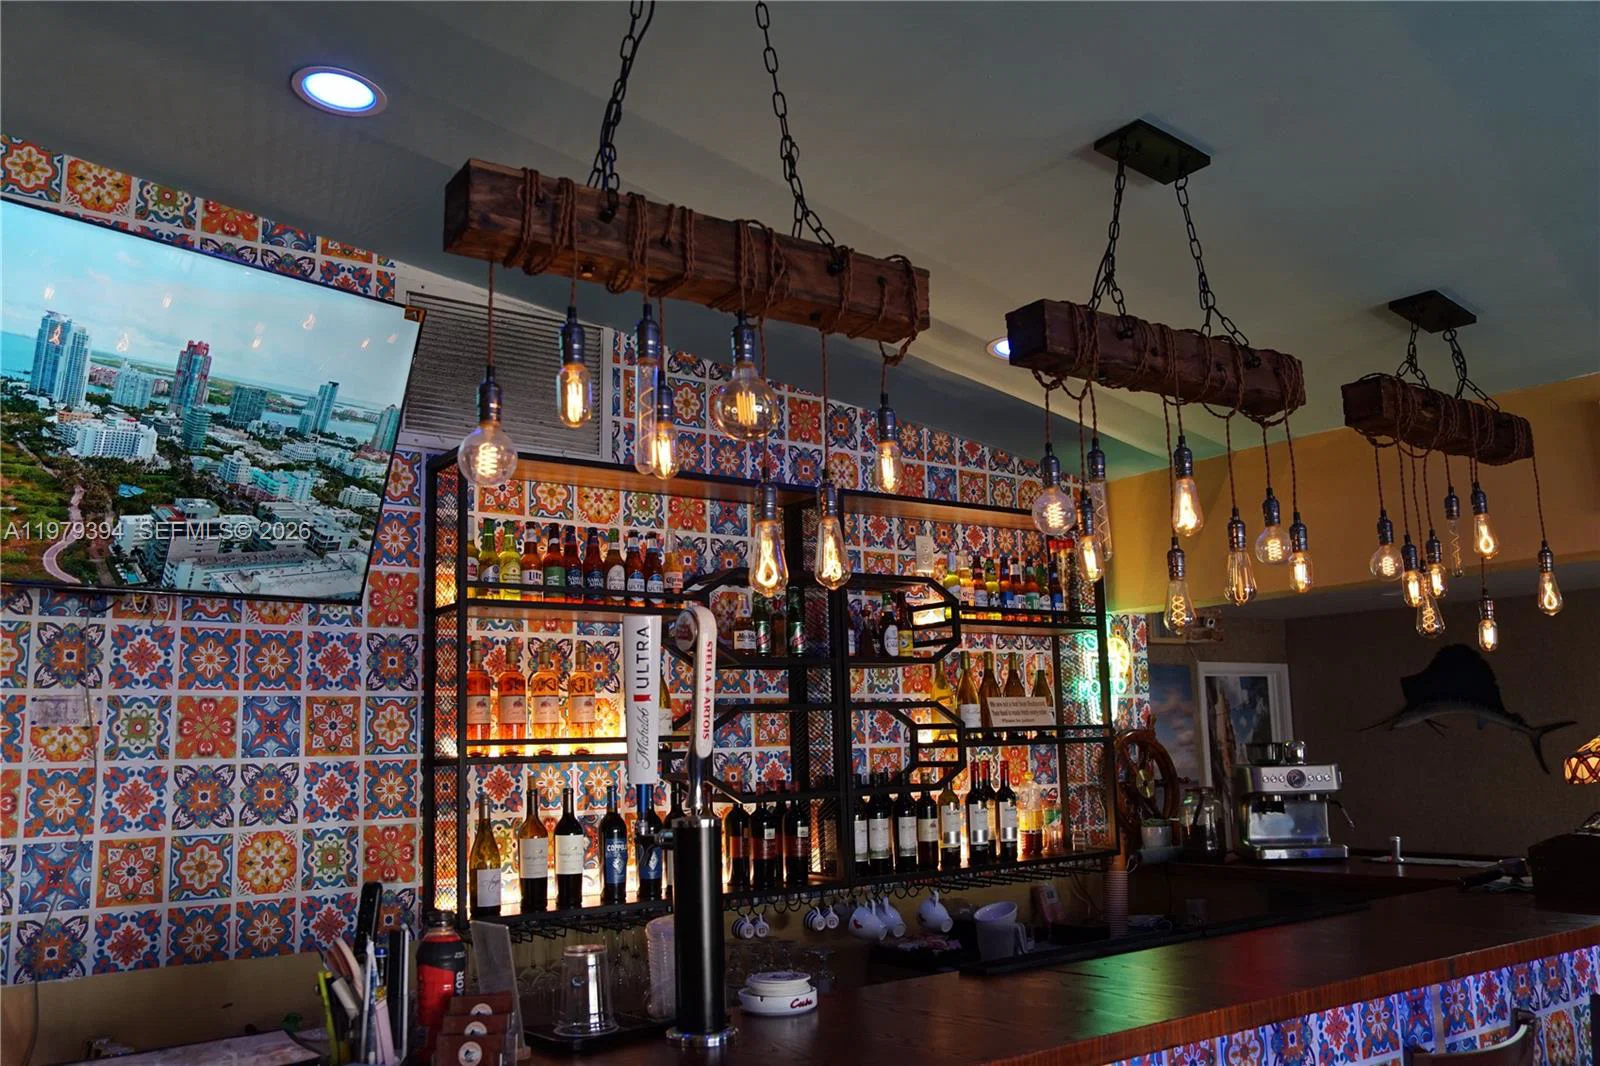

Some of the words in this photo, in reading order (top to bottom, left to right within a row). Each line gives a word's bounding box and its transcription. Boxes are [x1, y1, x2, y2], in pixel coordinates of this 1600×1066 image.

[636, 626, 650, 689] ULTRA
[704, 640, 713, 682] STELLA
[702, 698, 711, 741] ARTOIS
